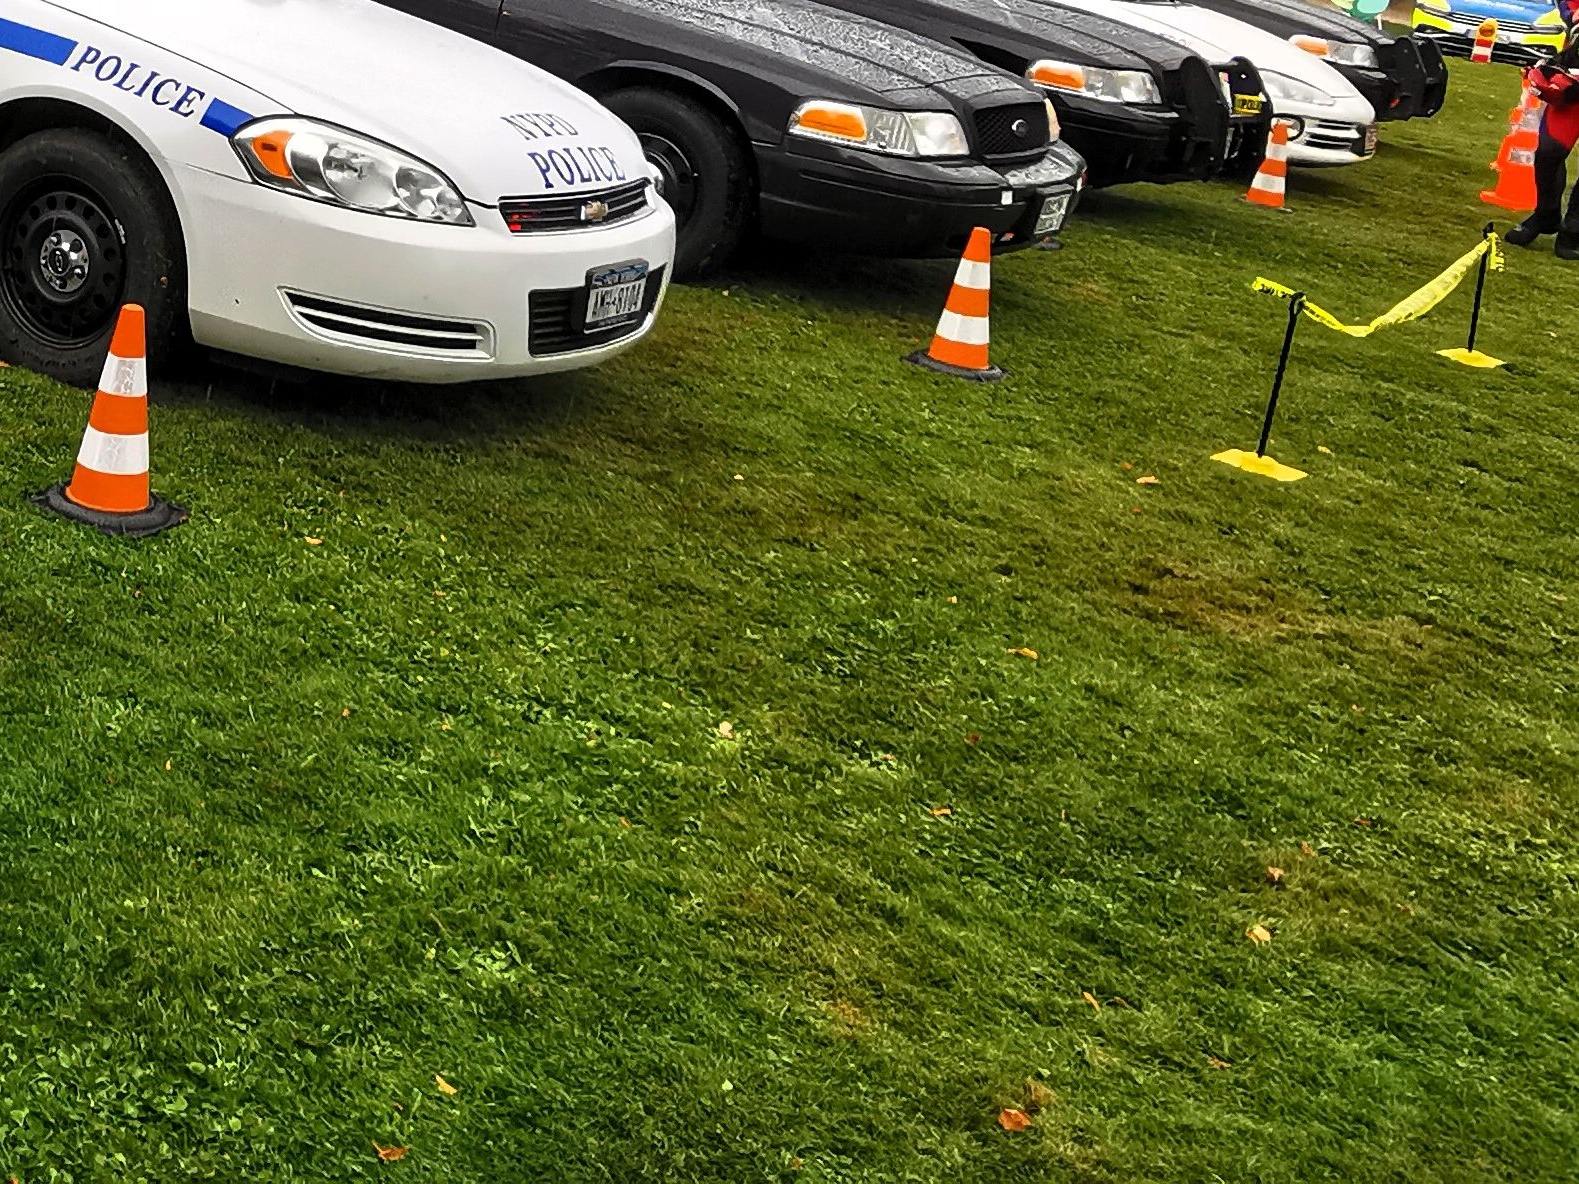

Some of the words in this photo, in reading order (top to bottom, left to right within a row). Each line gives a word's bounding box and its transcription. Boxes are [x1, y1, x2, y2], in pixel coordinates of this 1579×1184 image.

[70, 45, 206, 118] POLICE
[500, 112, 579, 141] NYPD
[527, 146, 627, 190] POLICE
